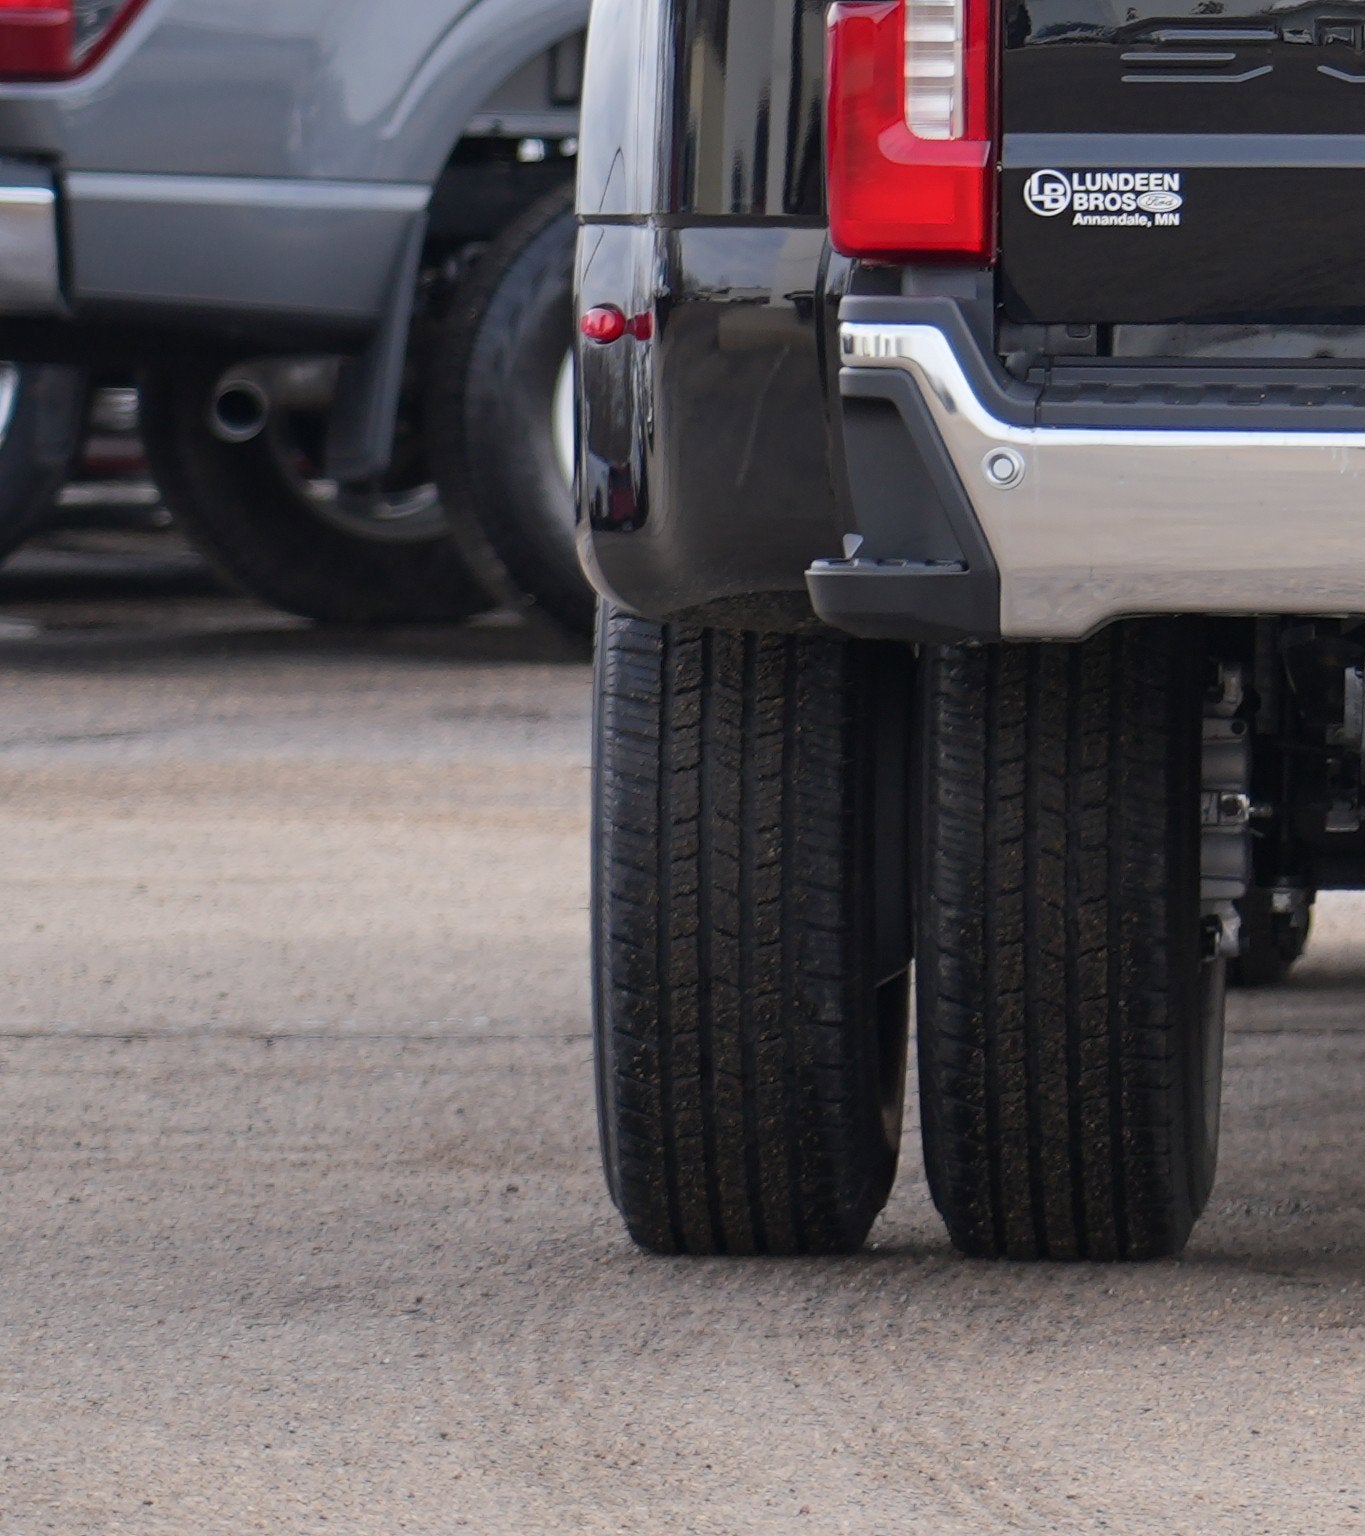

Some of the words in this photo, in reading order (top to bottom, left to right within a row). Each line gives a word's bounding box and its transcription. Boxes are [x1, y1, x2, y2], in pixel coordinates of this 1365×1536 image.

[1072, 172, 1180, 192] LUNDEEN
[1072, 192, 1137, 212] BROS
[1072, 212, 1152, 228] Annandale,
[1154, 212, 1180, 227] MN
